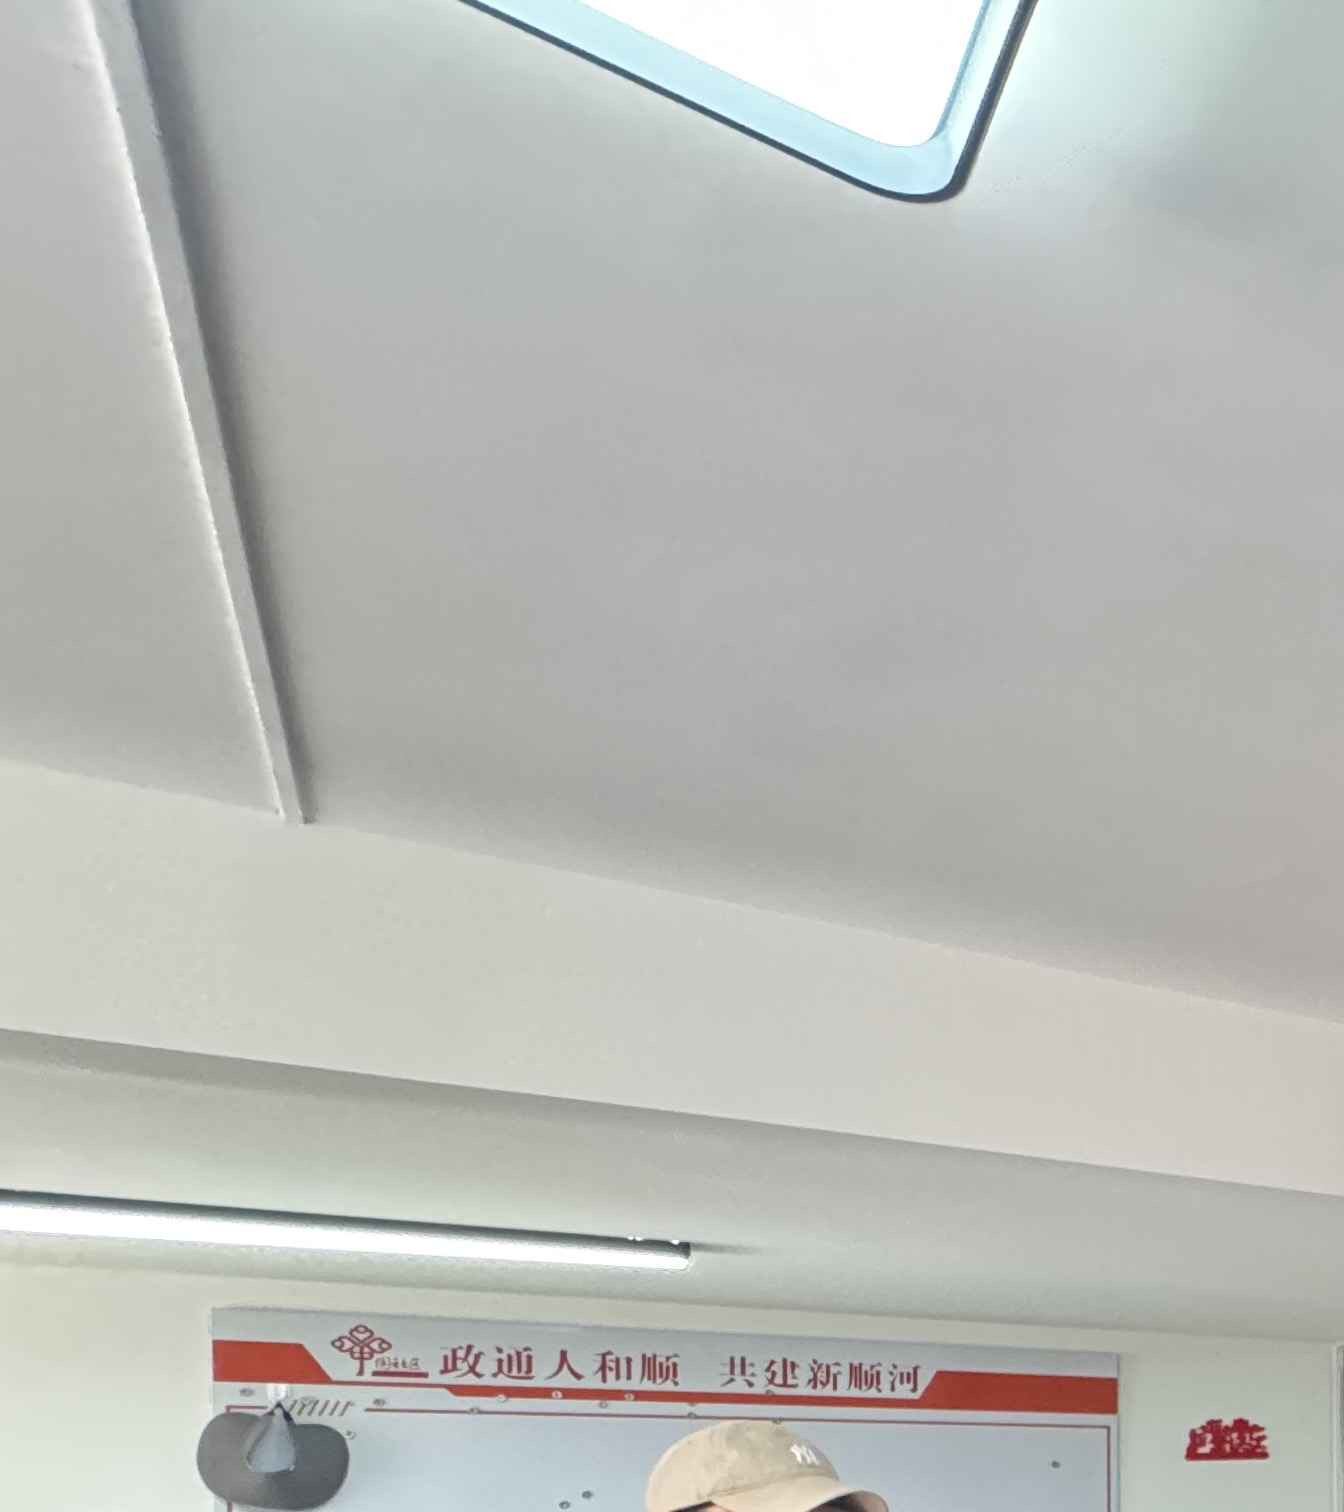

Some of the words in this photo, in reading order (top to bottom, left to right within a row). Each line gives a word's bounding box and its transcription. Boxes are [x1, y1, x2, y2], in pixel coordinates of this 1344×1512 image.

[438, 1343, 681, 1387] 政通人和顺
[718, 1355, 922, 1394] 共建新顺河
